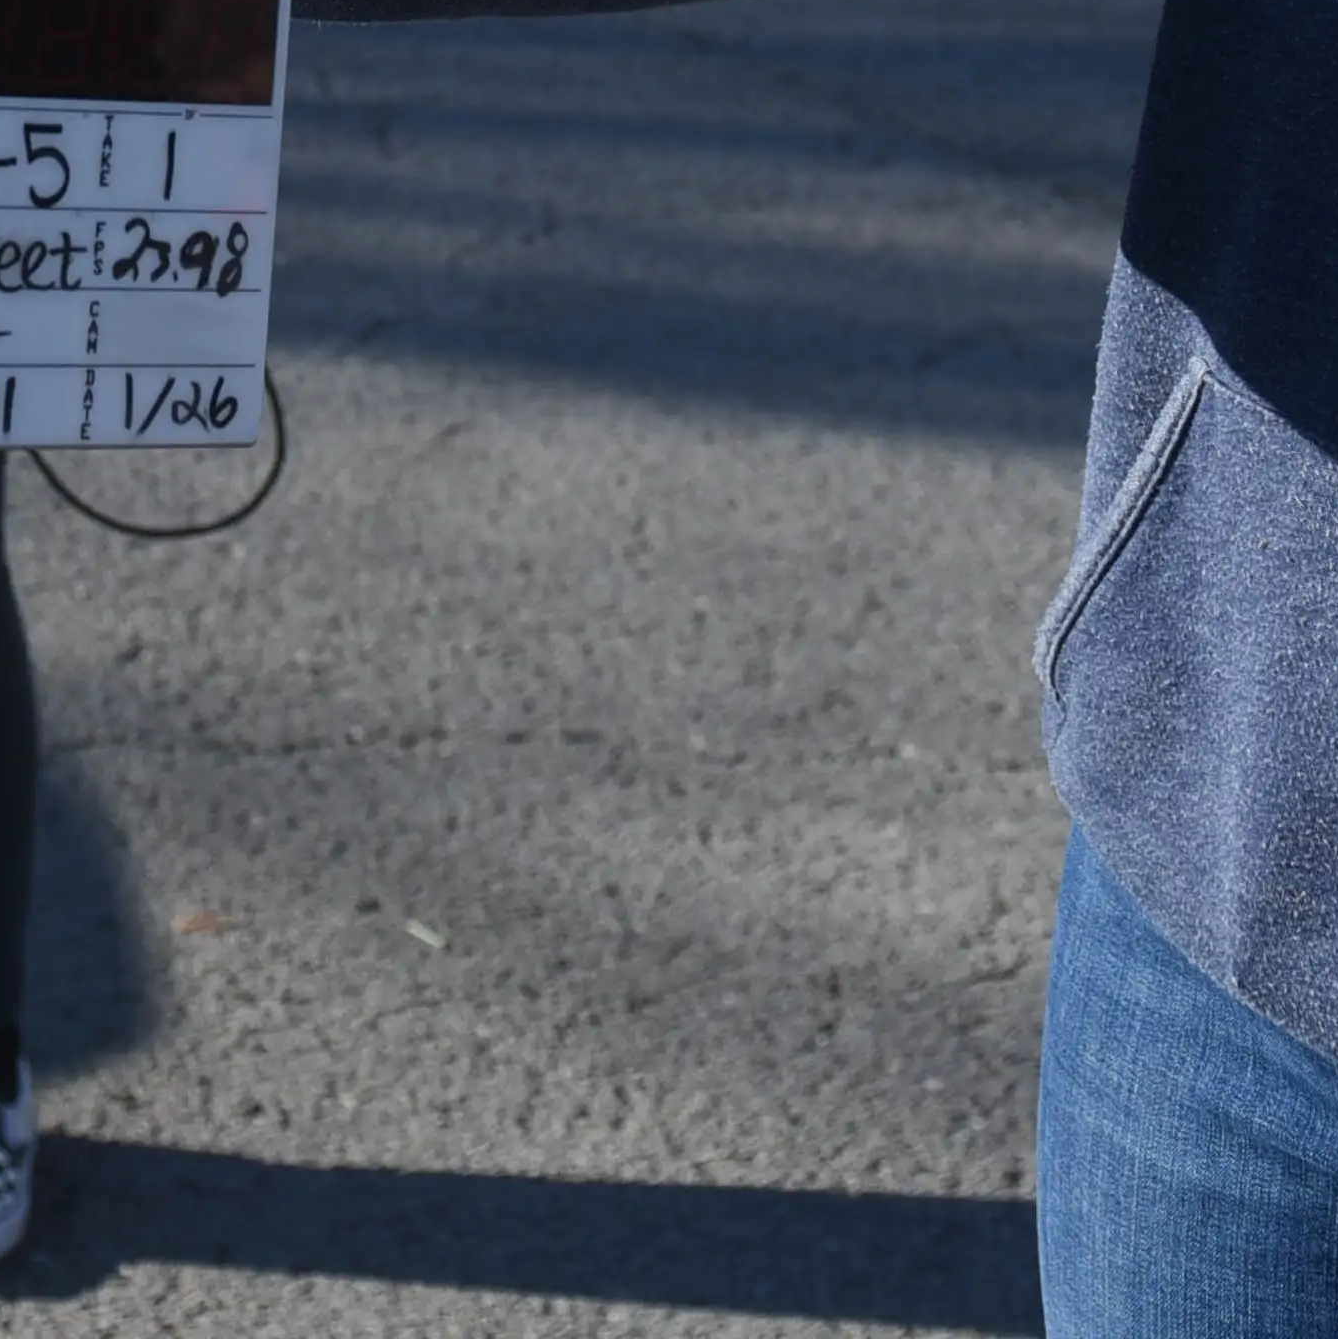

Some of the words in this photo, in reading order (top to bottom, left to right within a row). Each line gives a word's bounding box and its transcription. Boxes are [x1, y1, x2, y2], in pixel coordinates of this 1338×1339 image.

[99, 115, 114, 187] TAKE
[164, 130, 176, 201] 1
[93, 222, 106, 275] FPS
[112, 217, 249, 297] 23.98
[86, 301, 100, 354] CAM
[80, 369, 95, 441] DATE
[125, 372, 238, 436] 1/26
